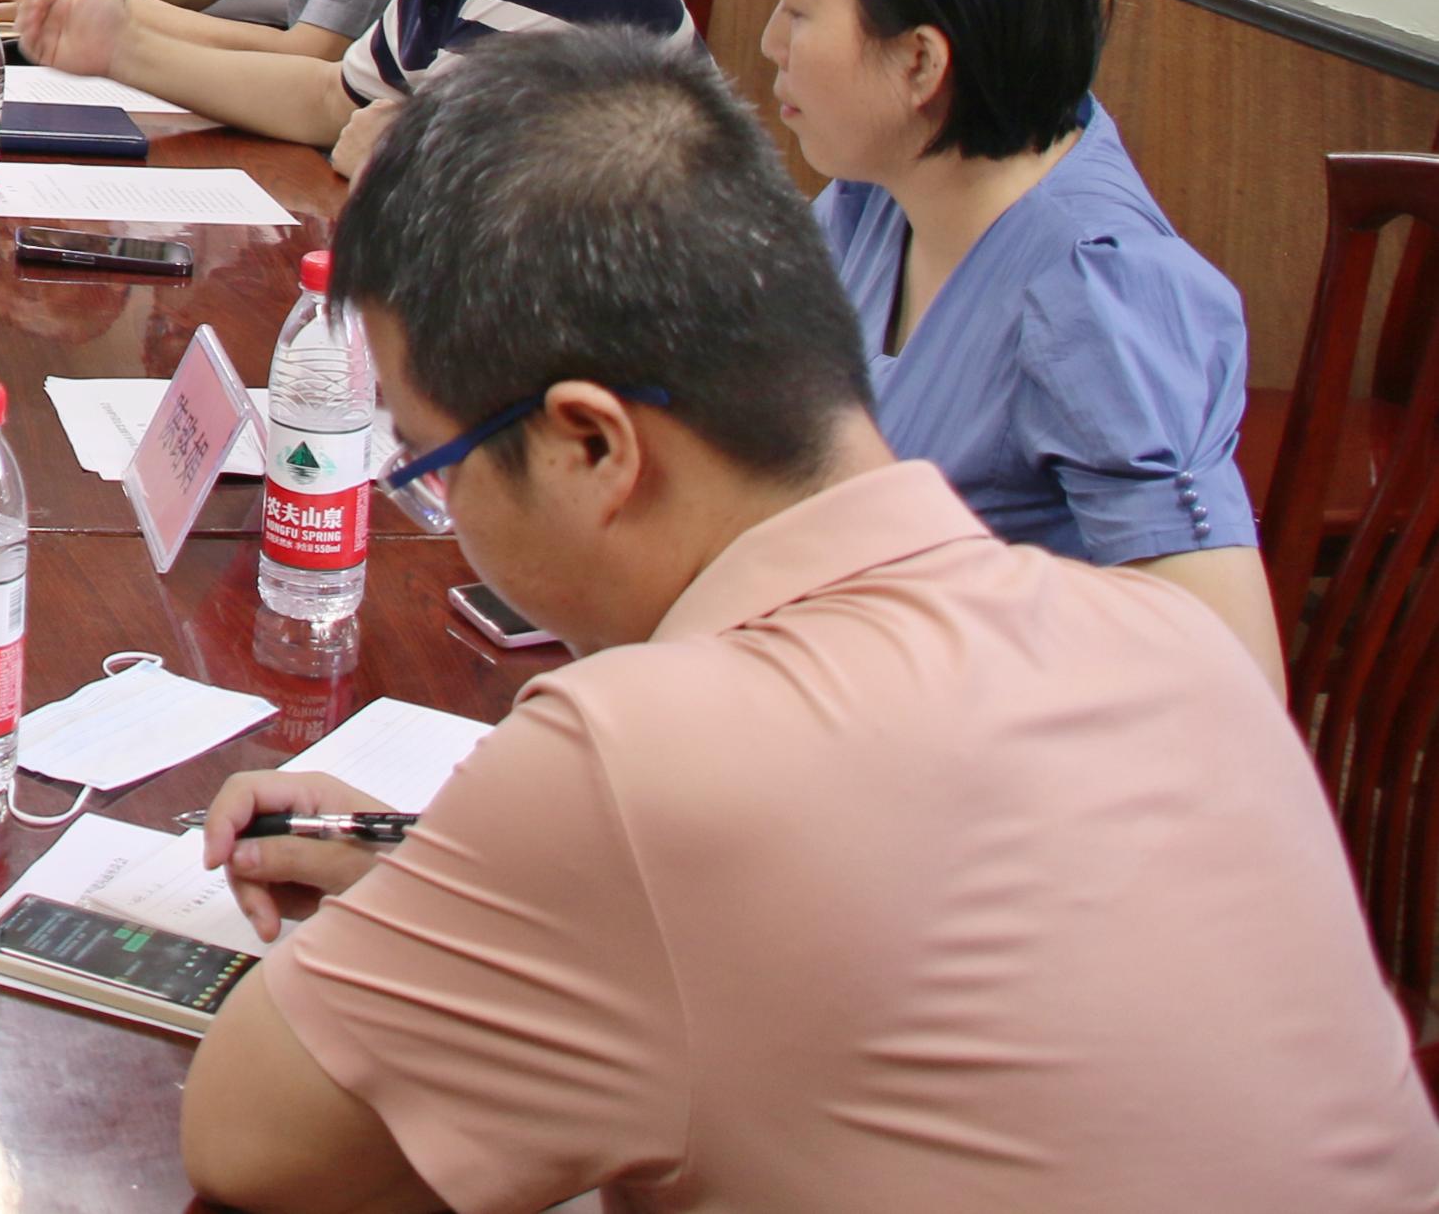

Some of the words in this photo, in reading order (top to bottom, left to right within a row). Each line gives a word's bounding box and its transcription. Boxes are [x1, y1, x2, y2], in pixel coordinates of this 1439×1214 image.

[267, 495, 344, 530] 农夫山泉
[301, 529, 343, 543] SPRING
